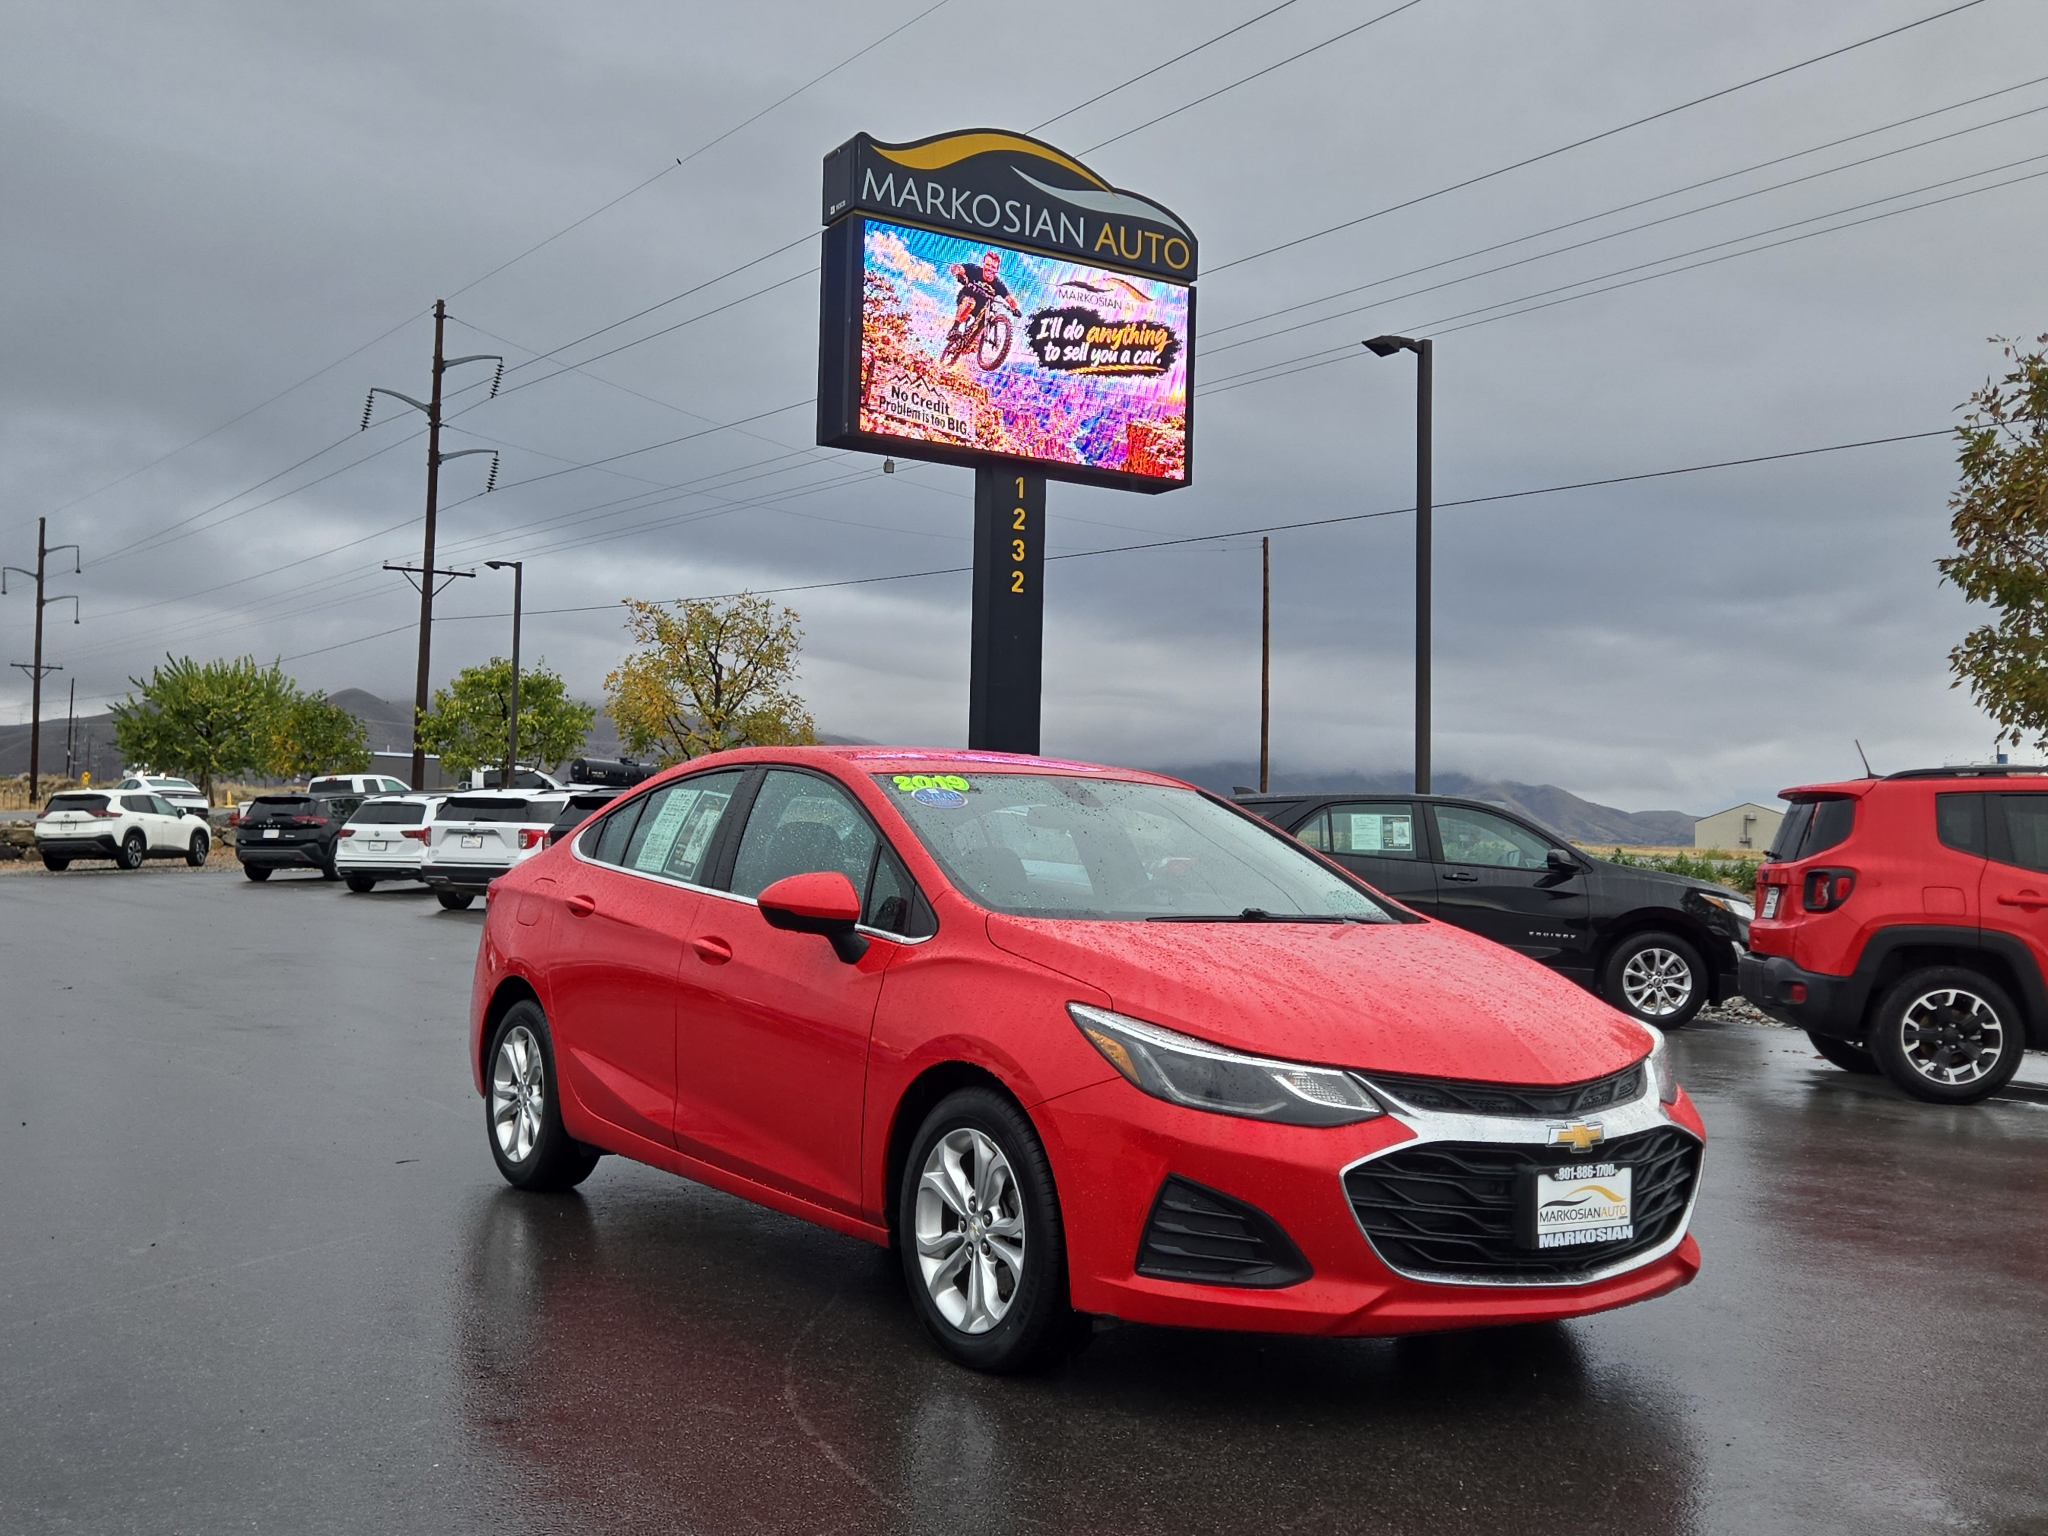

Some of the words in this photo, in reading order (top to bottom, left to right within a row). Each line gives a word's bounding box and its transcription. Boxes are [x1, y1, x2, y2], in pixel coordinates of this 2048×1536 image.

[862, 168, 1085, 248] MARKOSIAN
[1094, 223, 1190, 270] AUTO
[1058, 289, 1122, 310] MARKOSIAN
[1036, 316, 1063, 340] I'll
[1063, 318, 1084, 341] do
[1086, 323, 1172, 353] anything
[1044, 341, 1061, 361] to
[1062, 342, 1090, 362] sell
[1091, 348, 1122, 367] you
[1120, 350, 1130, 363] a
[1133, 349, 1162, 365] car.
[879, 396, 921, 421] Problem
[922, 409, 930, 424] is
[931, 414, 945, 428] too
[891, 386, 908, 402] No
[911, 393, 950, 415] Credit
[892, 775, 970, 791] 2019
[1558, 1164, 1615, 1180] 801-886-1700
[1538, 1225, 1633, 1249] MARKOSIAN
